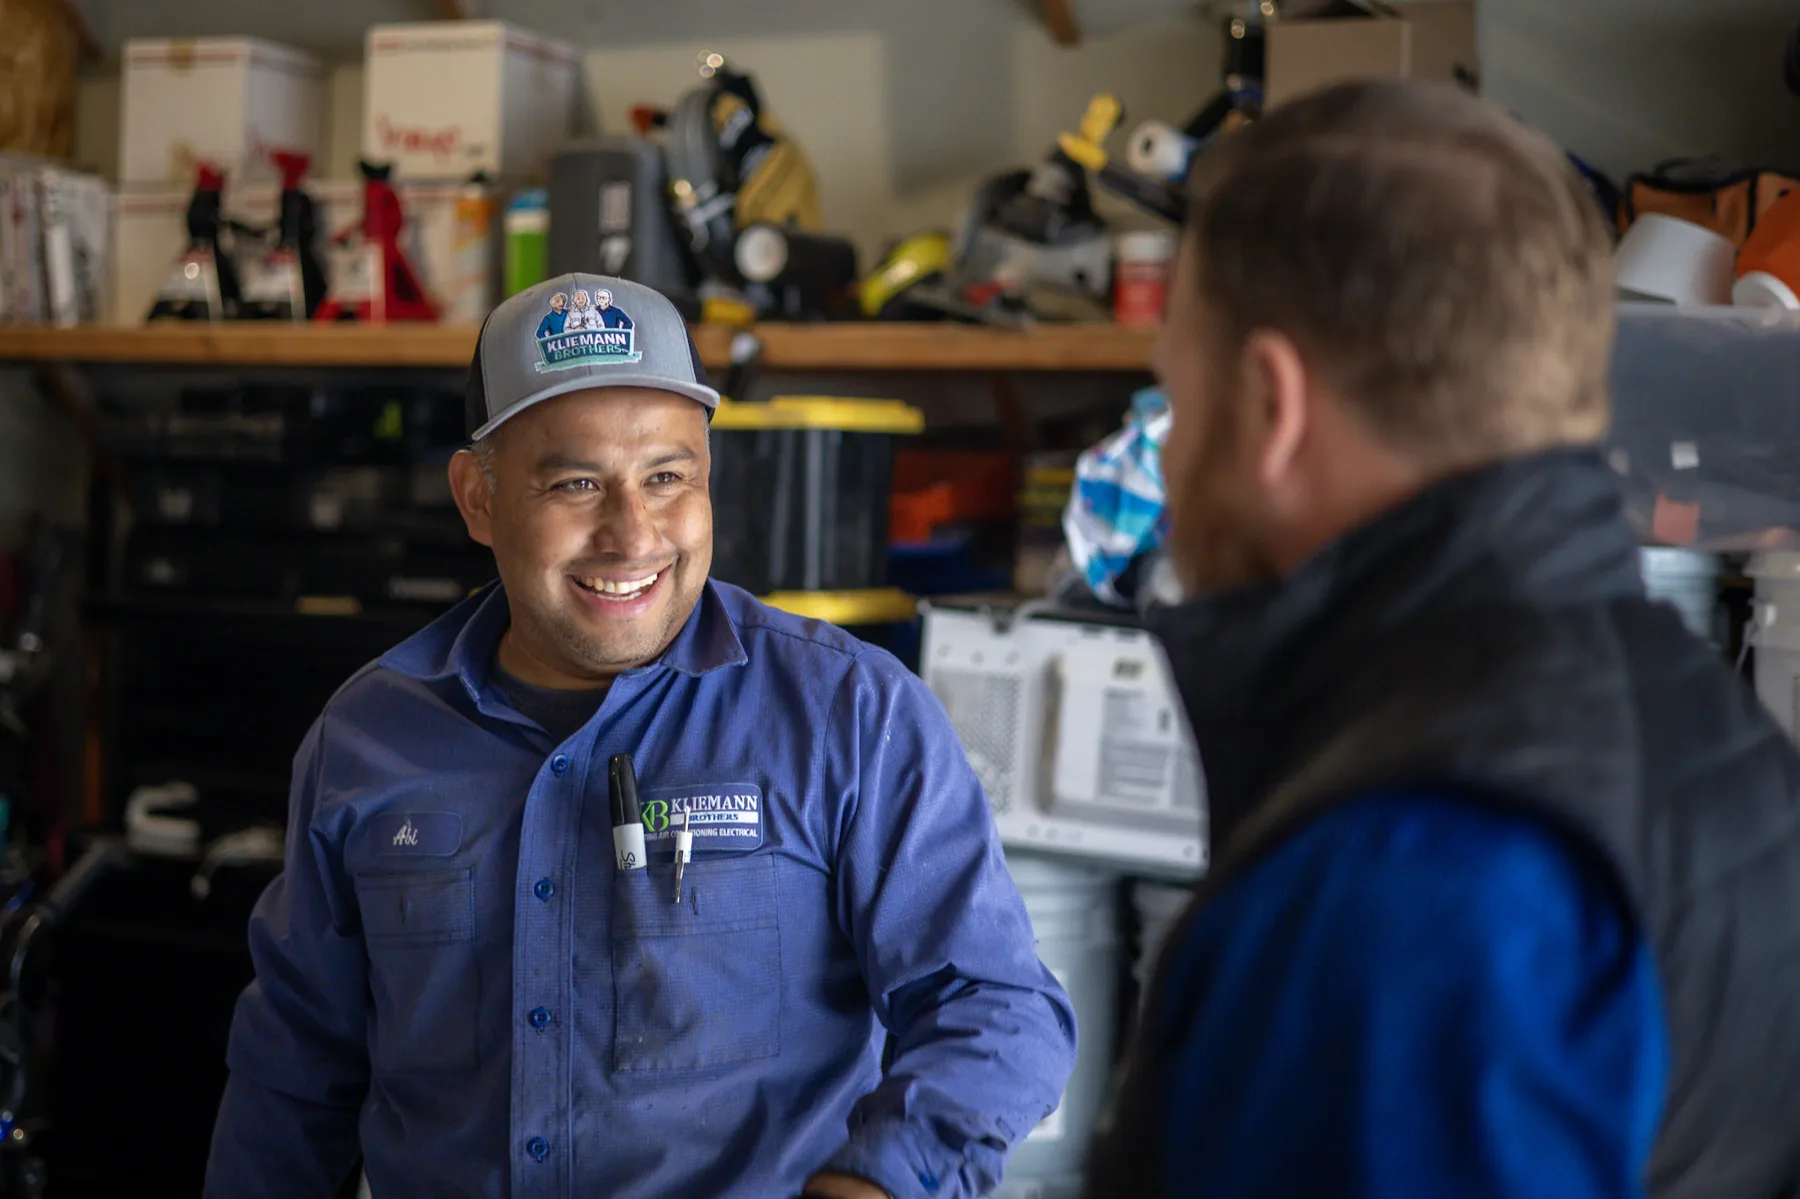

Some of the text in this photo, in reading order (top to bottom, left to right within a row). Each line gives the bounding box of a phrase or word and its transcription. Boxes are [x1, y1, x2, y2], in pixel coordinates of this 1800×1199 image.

[547, 333, 626, 353] KLIEMANN
[554, 344, 621, 360] BROTHERS
[671, 795, 758, 813] KLIEMANN
[658, 831, 669, 840] AIR
[670, 829, 718, 840] COTIONING
[719, 828, 758, 839] ELECTRICAL
